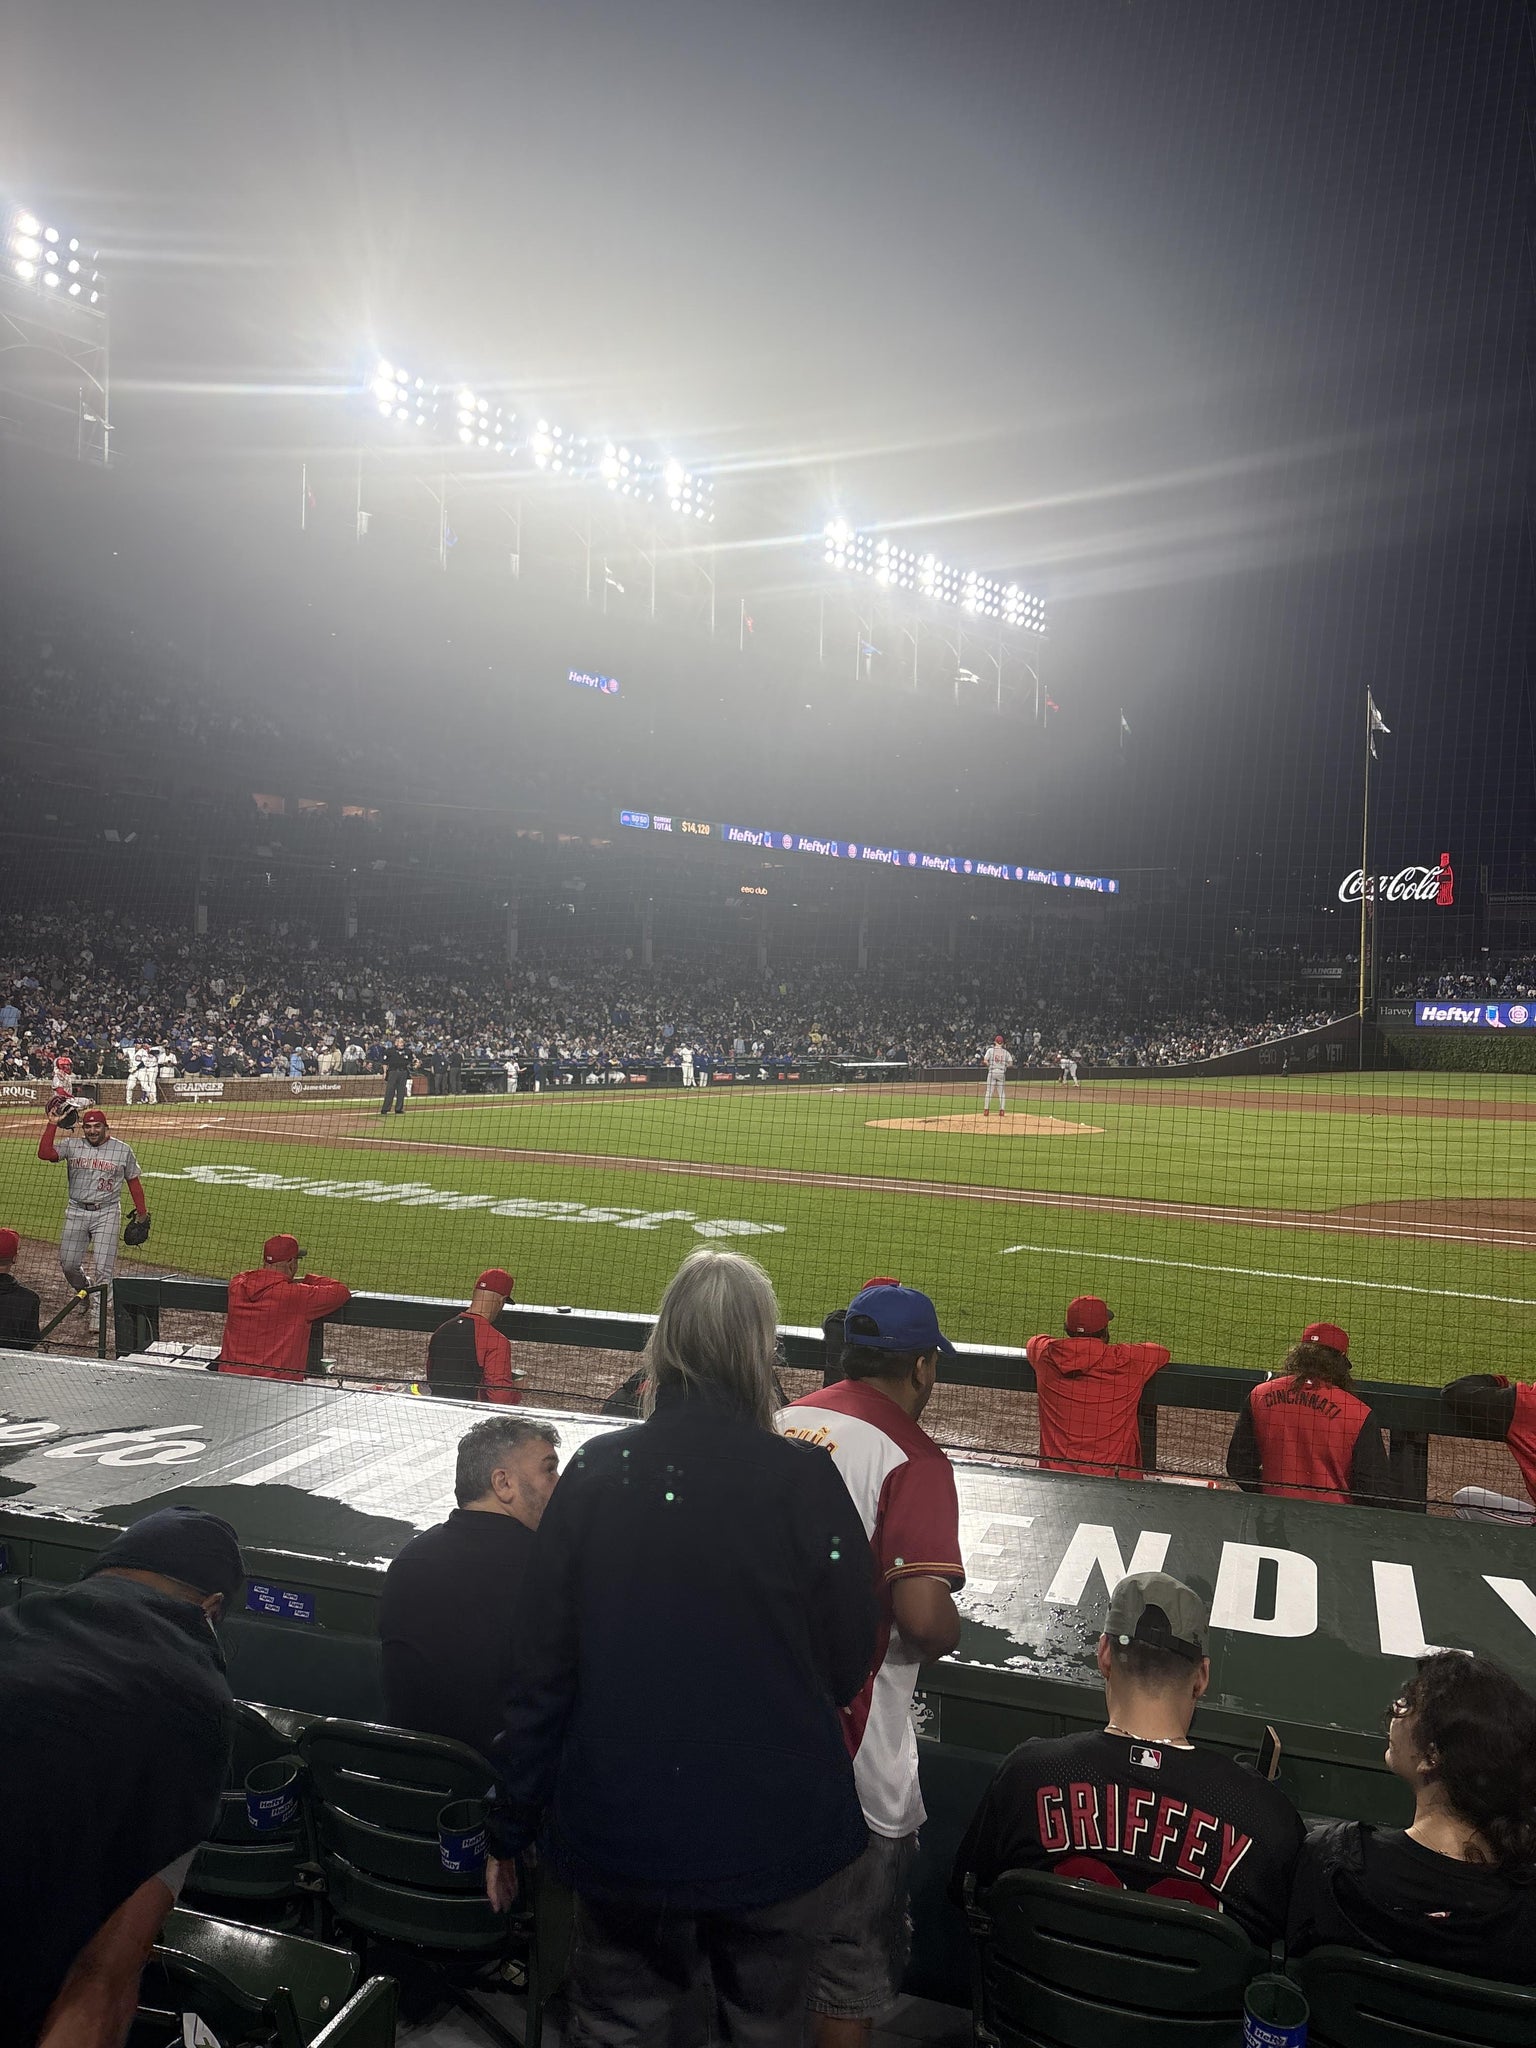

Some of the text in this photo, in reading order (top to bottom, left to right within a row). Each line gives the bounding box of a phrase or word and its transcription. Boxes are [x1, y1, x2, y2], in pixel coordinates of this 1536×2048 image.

[568, 671, 599, 688] Hefty!
[653, 822, 673, 832] TOTAL
[681, 820, 711, 836] $14,120
[728, 828, 763, 846] Hefty!
[798, 838, 831, 855] Hefty!
[862, 848, 892, 863] Hefty!
[921, 855, 950, 871] Hefty!
[976, 863, 1002, 878] Hefty!
[1027, 870, 1052, 884] Hefty!
[1074, 876, 1097, 890] Hefty!
[1301, 967, 1343, 975] GRAINGER
[1380, 1006, 1413, 1017] Harvey
[1421, 1006, 1481, 1024] Hefty!
[1325, 1044, 1343, 1061] YETI
[173, 1082, 224, 1092] GRAINGER
[1036, 1782, 1253, 1893] GRIFFEY
